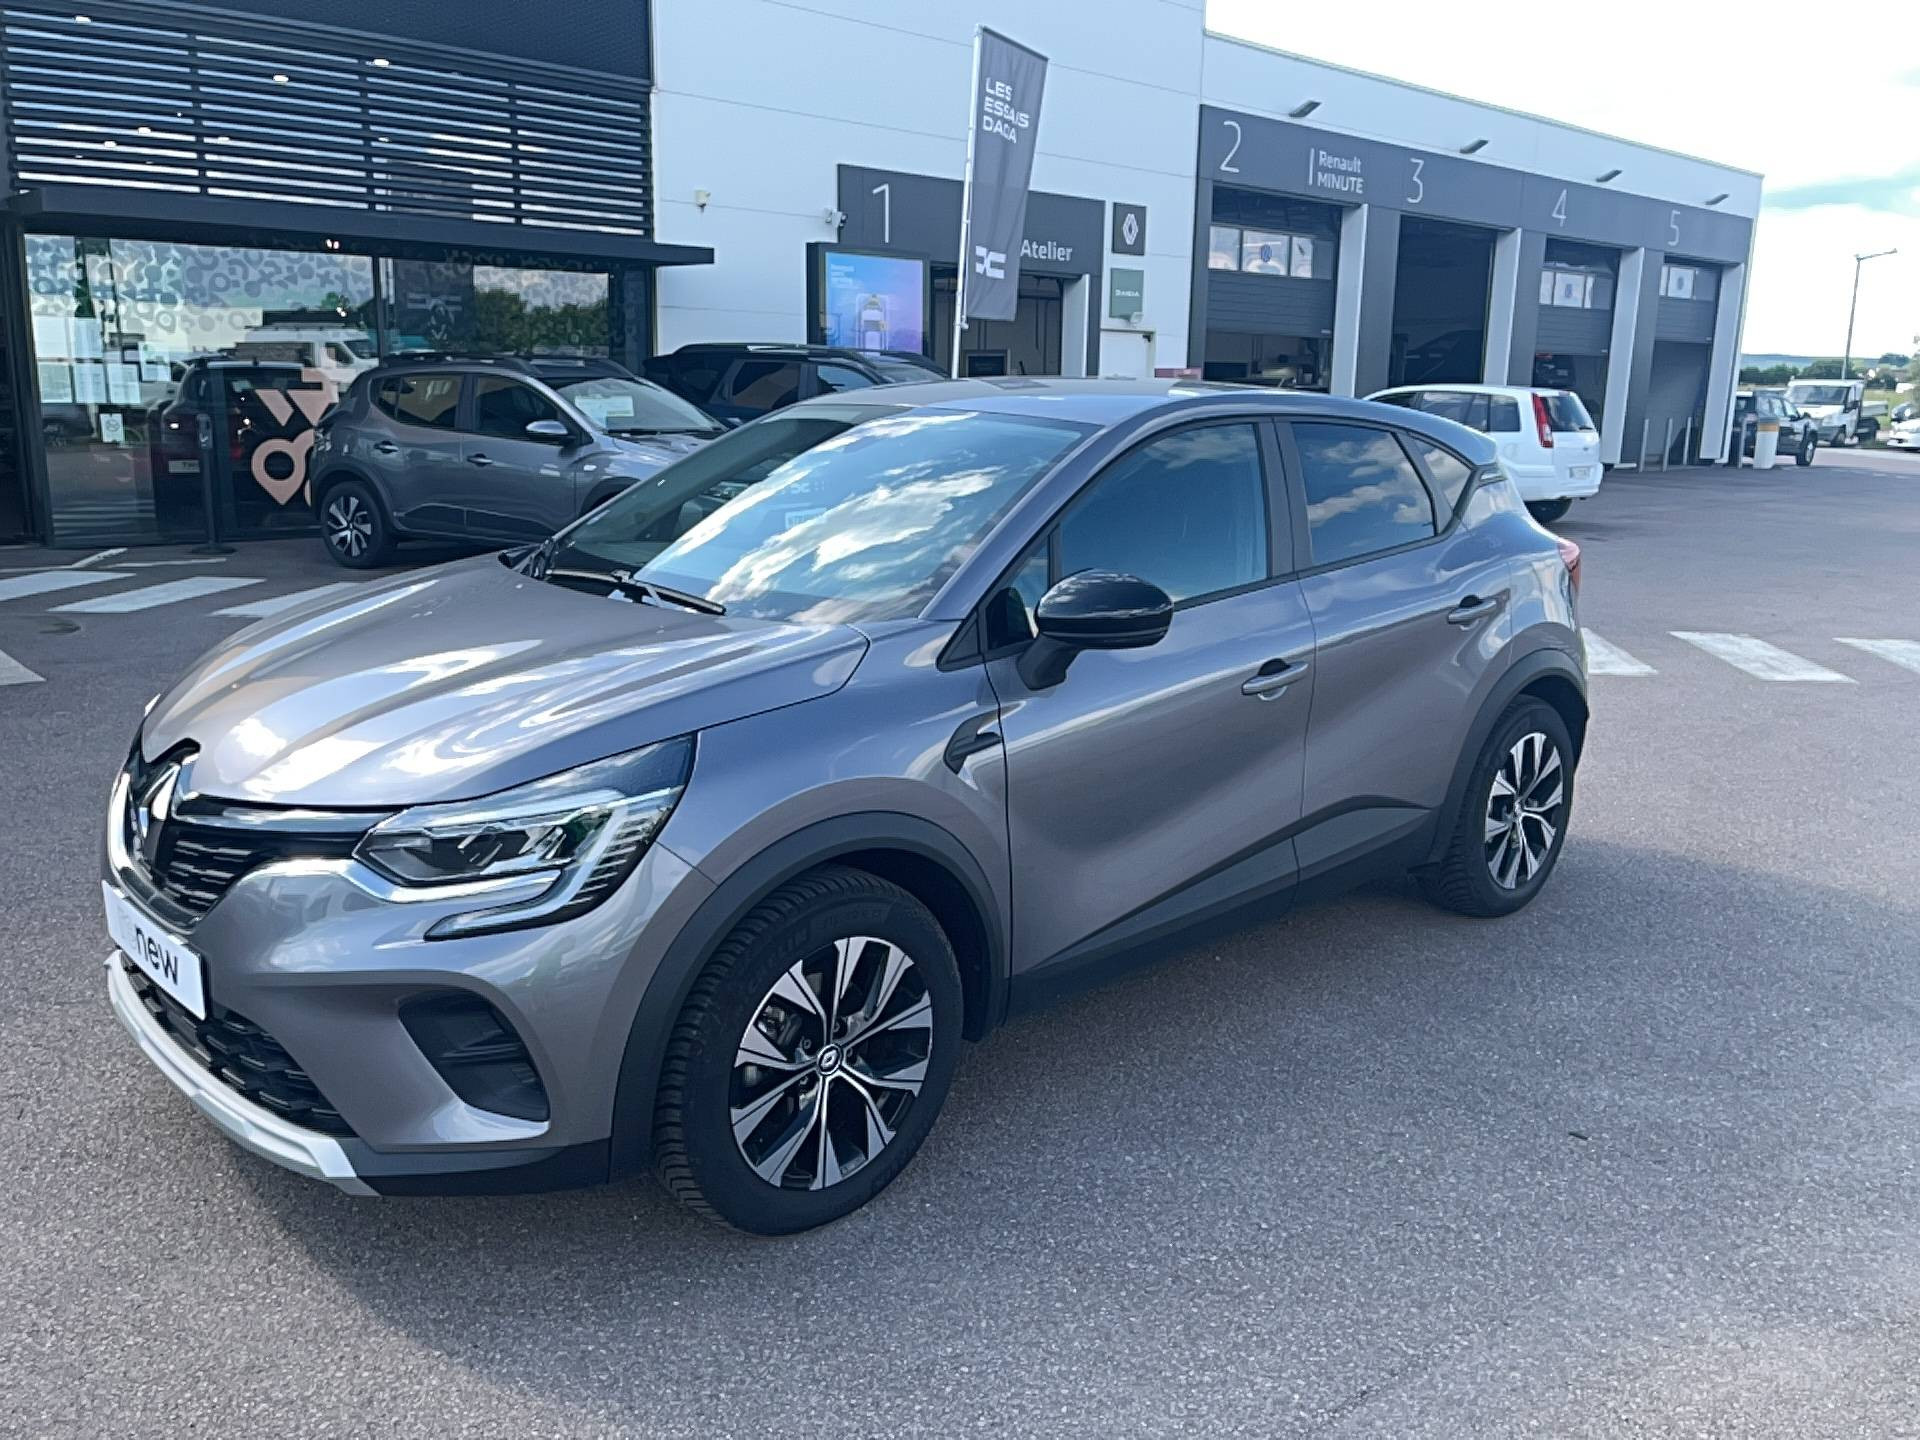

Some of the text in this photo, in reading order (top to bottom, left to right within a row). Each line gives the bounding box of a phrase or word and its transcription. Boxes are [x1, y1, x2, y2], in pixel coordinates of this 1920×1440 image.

[986, 77, 1012, 101] LES
[984, 96, 1029, 128] ESSAIS
[1220, 120, 1241, 173] 2
[1318, 150, 1362, 173] Renault
[1317, 171, 1364, 194] MINUTE
[1406, 158, 1424, 203] 3
[872, 183, 889, 243] 1
[1551, 188, 1568, 227] 4
[1668, 209, 1681, 246] 5
[1020, 239, 1073, 262] Atelier
